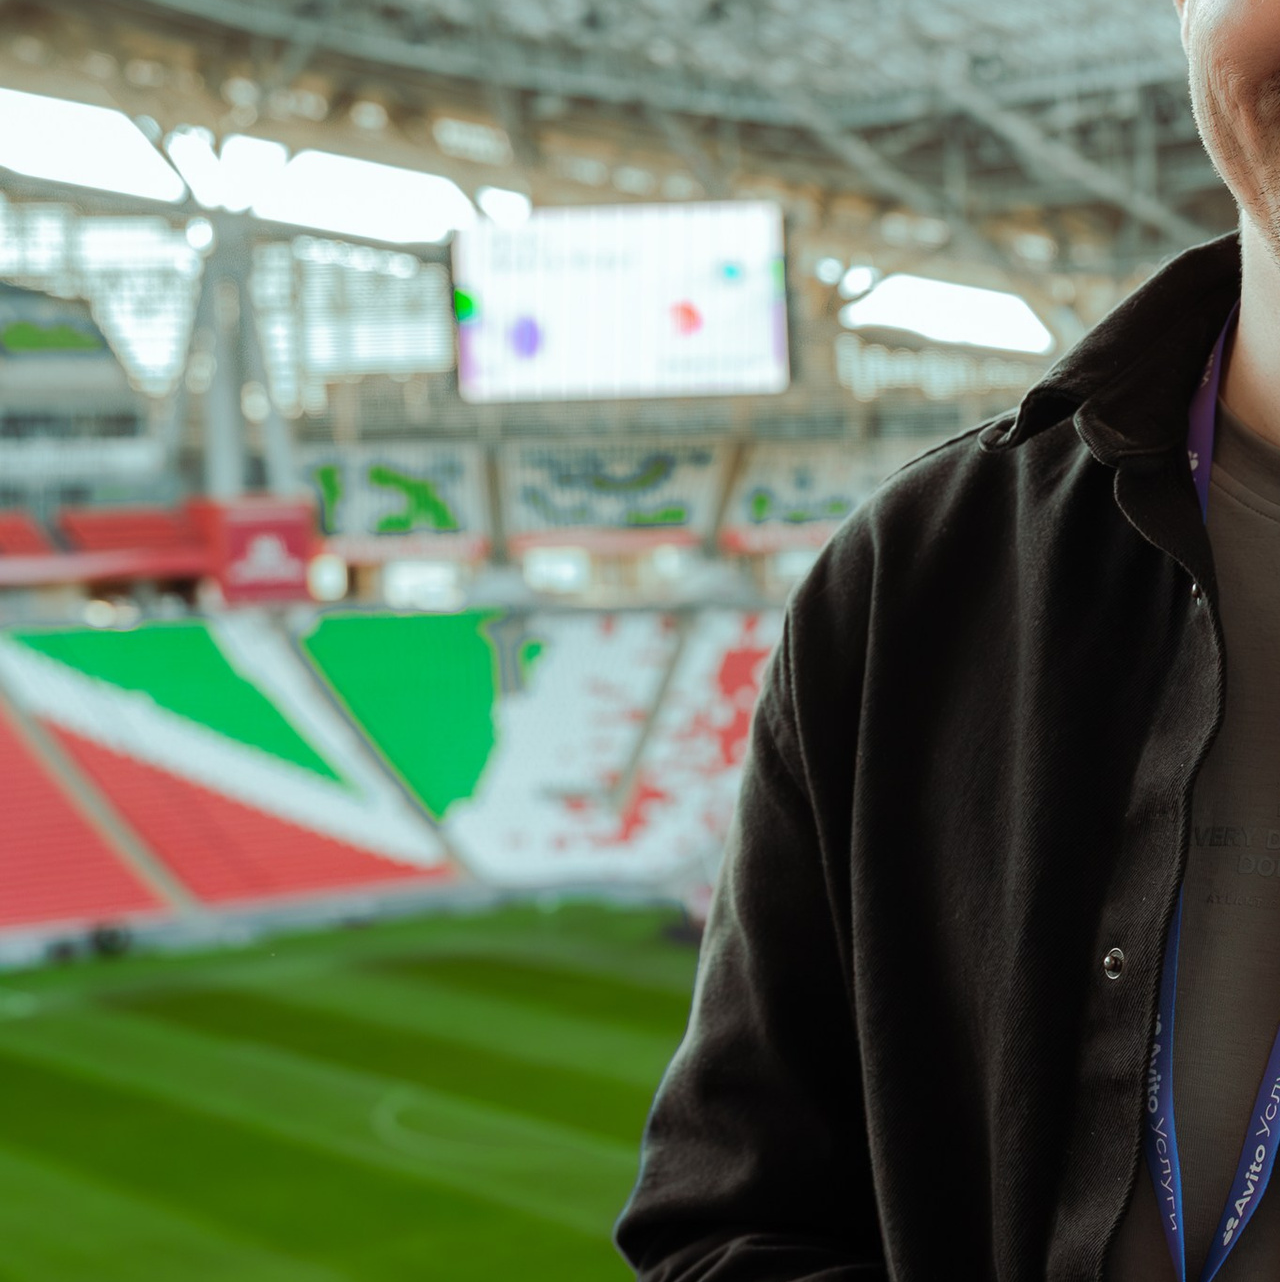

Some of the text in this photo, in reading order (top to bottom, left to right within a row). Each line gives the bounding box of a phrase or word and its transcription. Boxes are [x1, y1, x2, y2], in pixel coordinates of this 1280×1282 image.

[1191, 826, 1257, 848] VERY
[1151, 1117, 1177, 1231] Услуги
[1234, 1144, 1266, 1217] Avito
